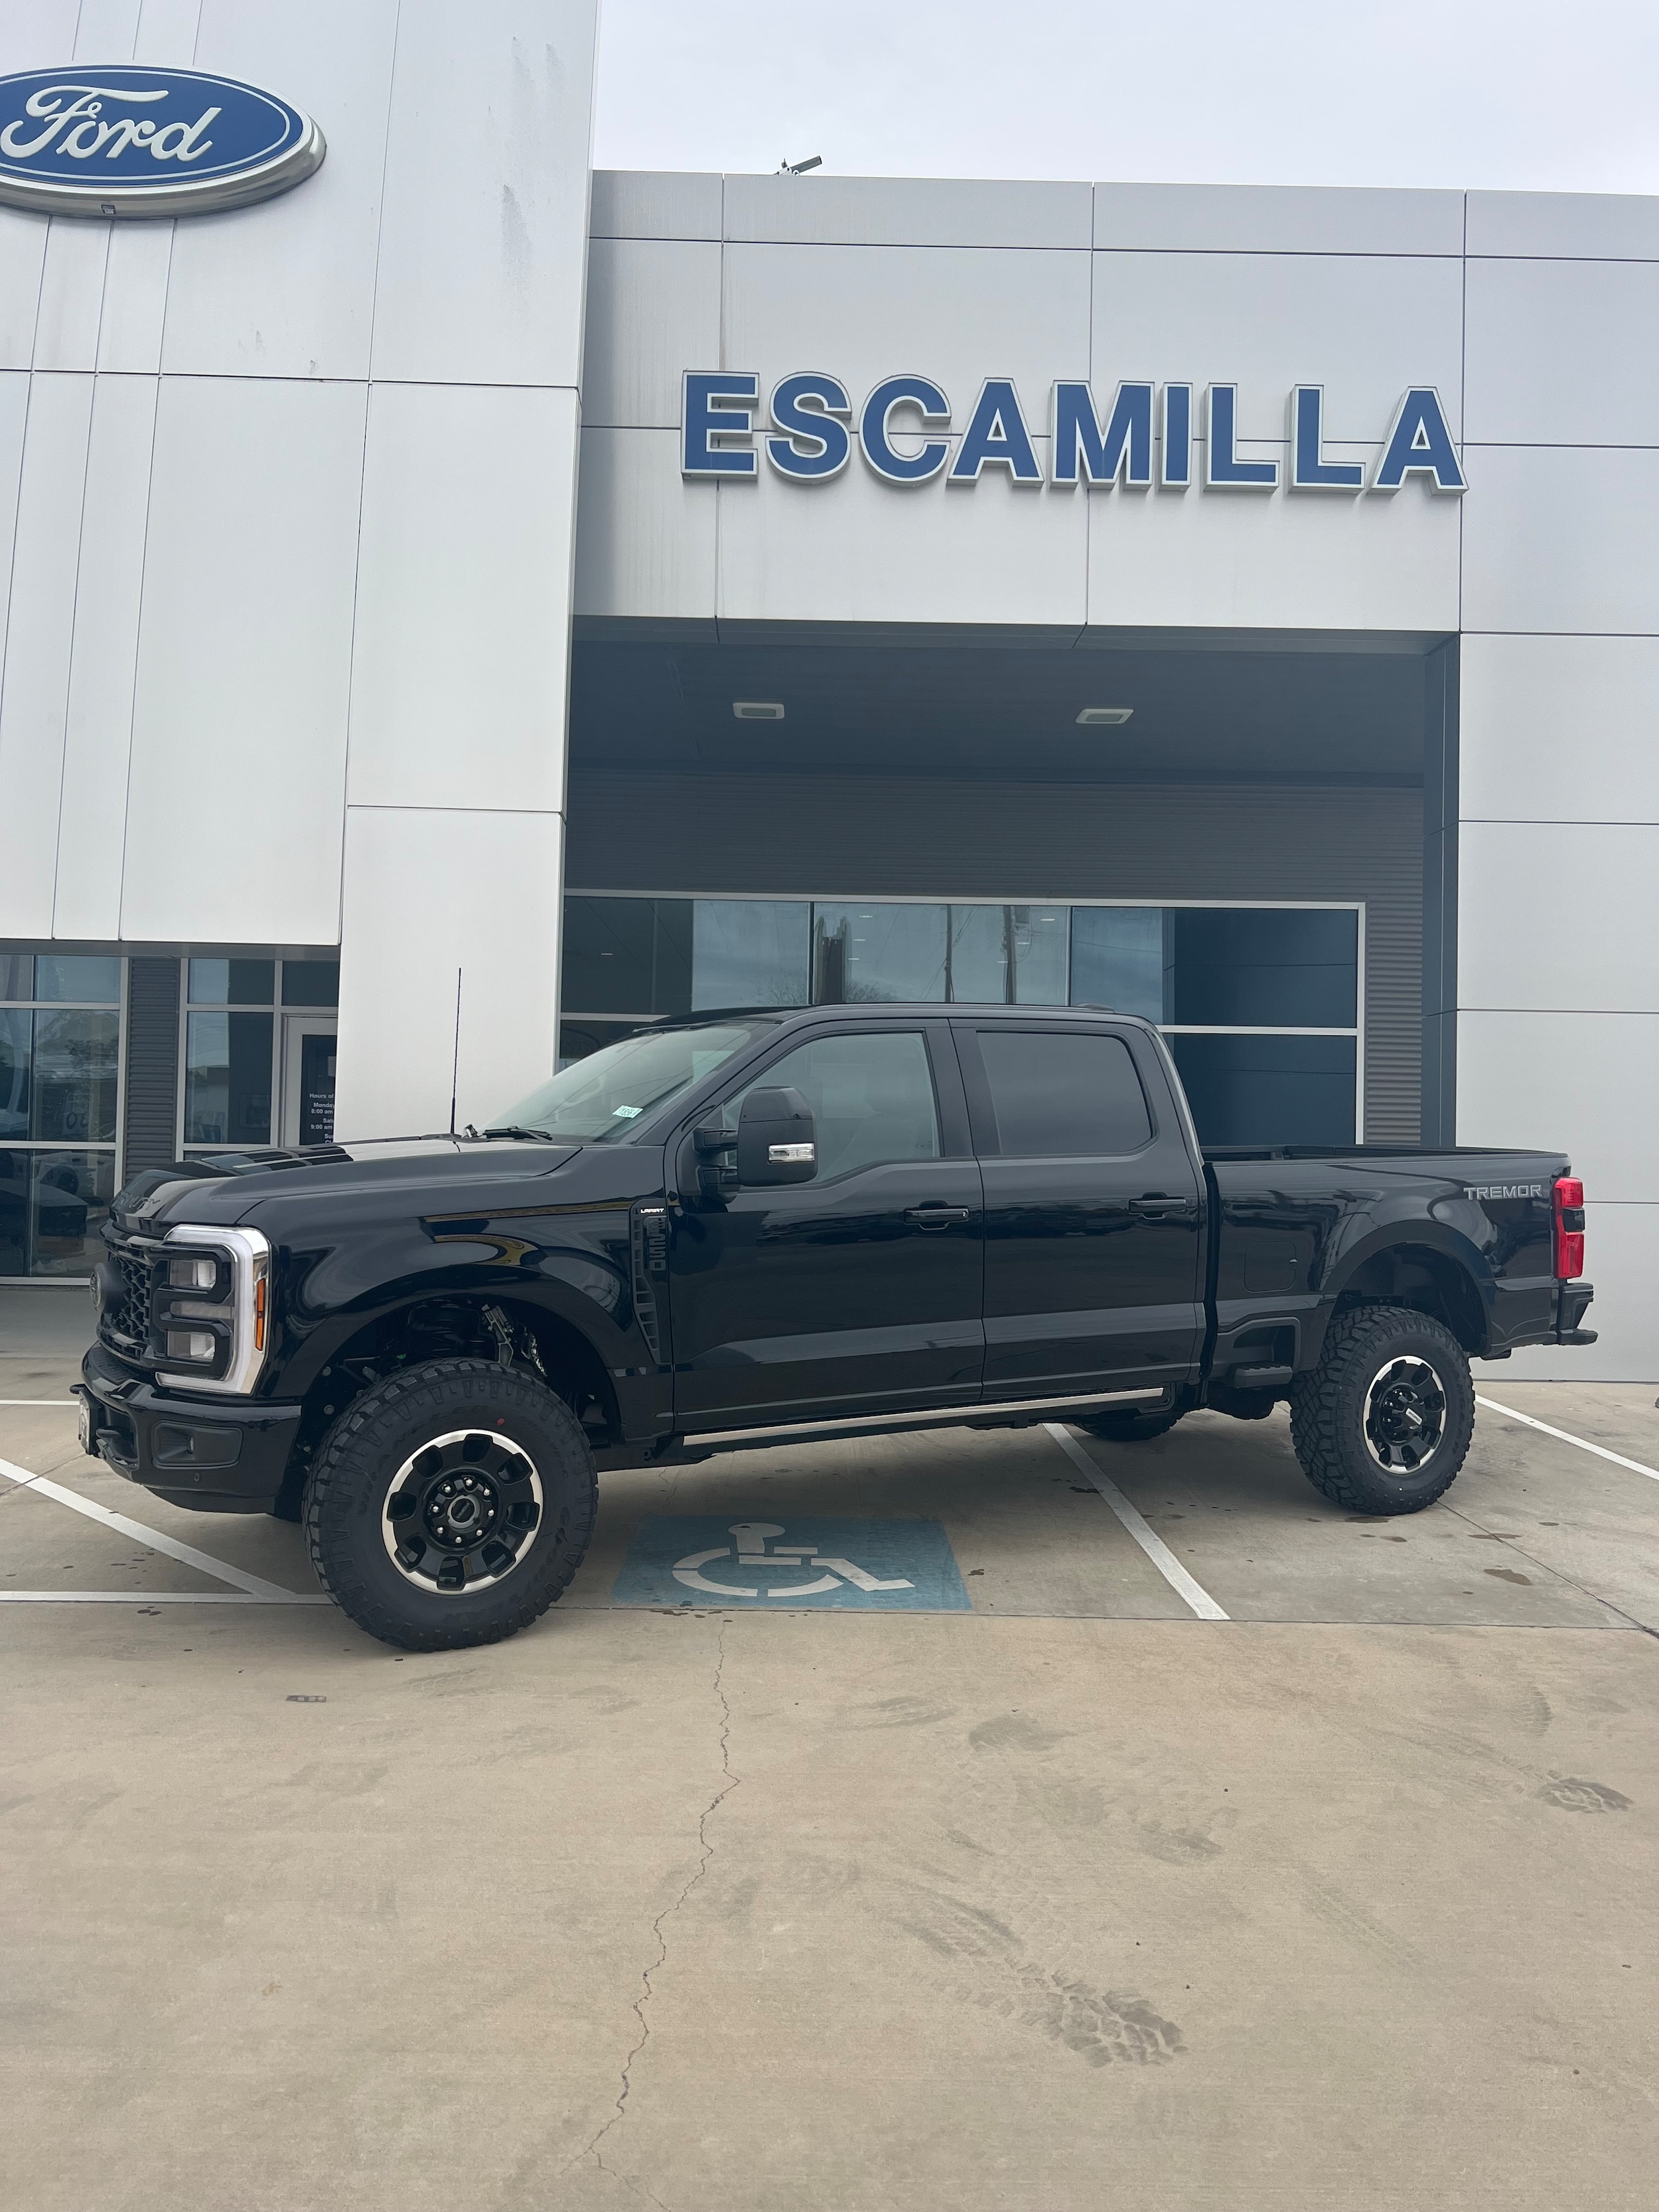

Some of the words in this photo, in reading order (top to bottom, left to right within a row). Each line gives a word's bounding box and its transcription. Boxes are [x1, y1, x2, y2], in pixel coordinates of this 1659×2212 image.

[1, 85, 222, 161] Ford
[682, 369, 1469, 495] ESCAMILLA
[1463, 1185, 1543, 1201] TREMOR
